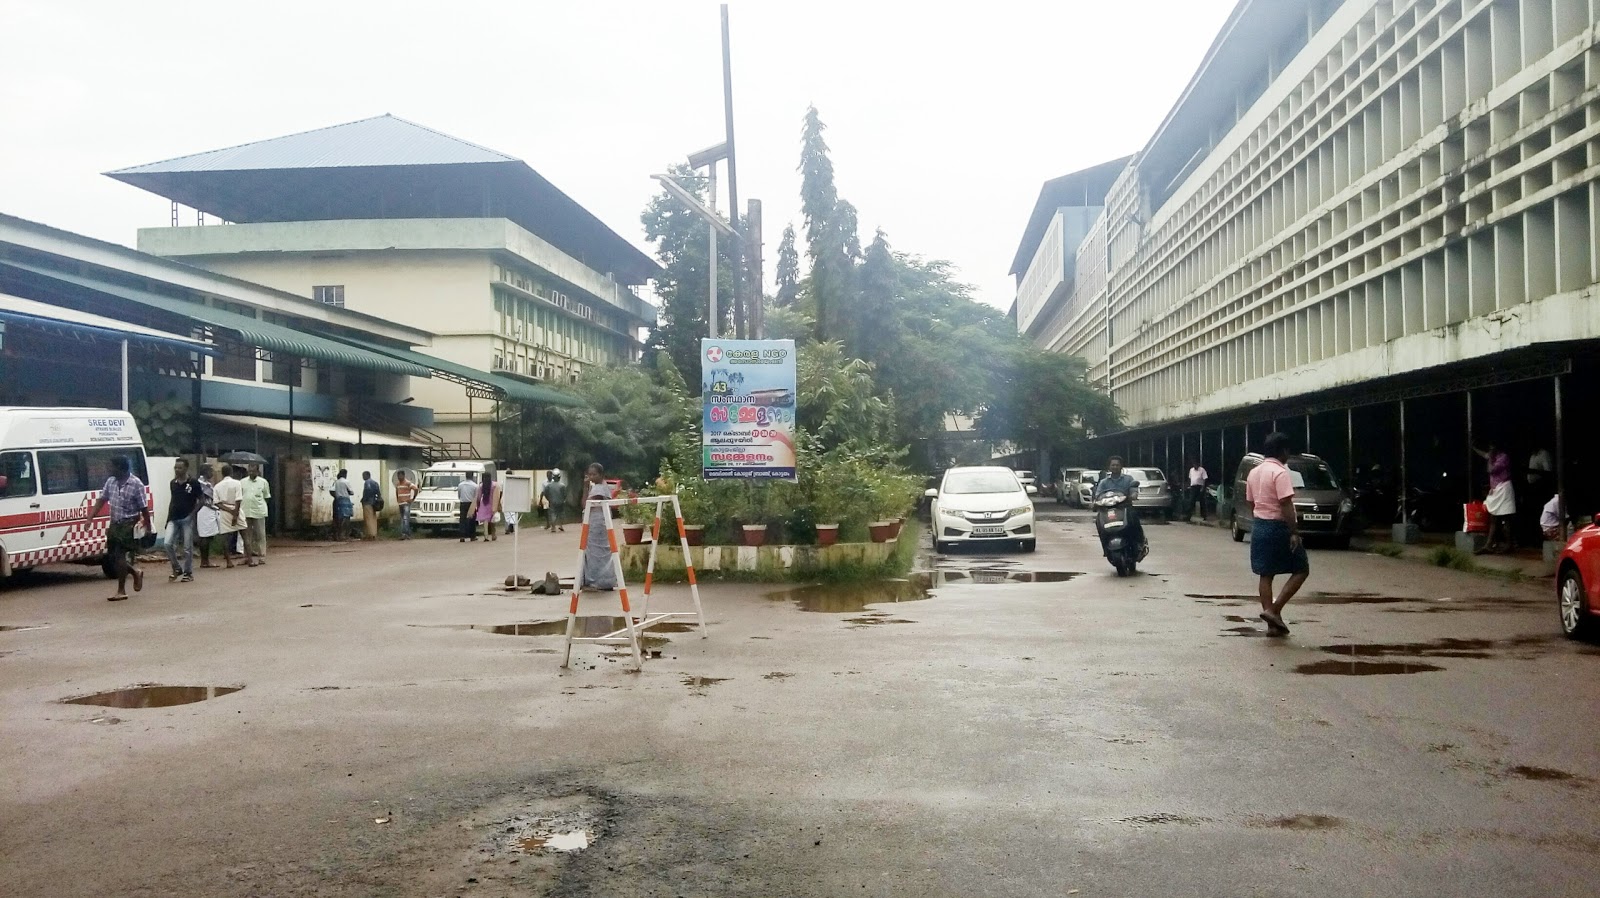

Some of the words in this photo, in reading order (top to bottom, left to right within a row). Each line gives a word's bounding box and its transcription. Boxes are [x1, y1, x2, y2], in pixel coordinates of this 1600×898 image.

[726, 349, 760, 361] കേരള
[763, 349, 788, 358] NGO
[88, 419, 107, 427] SREE
[108, 419, 125, 427] DEVI
[46, 507, 87, 522] AMBULANCE
